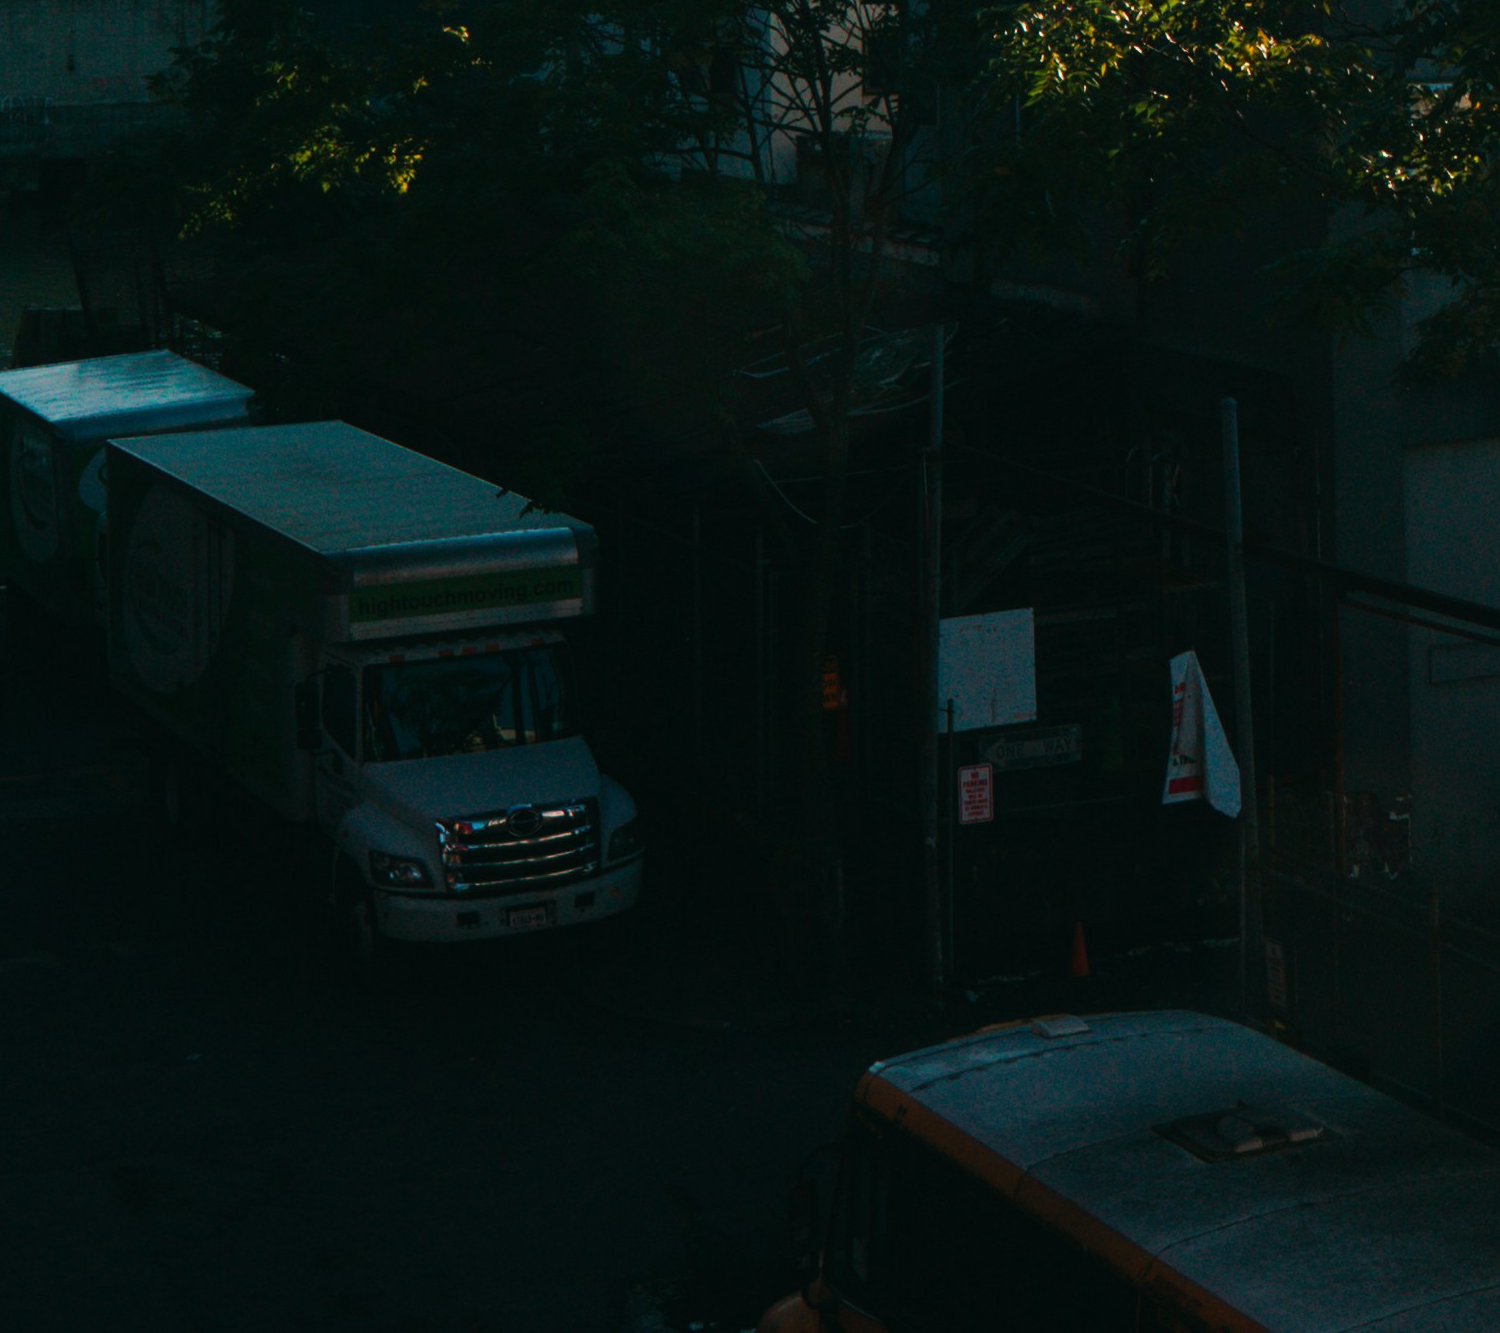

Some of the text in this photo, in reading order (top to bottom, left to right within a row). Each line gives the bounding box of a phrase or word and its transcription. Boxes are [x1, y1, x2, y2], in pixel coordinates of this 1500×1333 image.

[358, 580, 573, 616] hightouchmoving.com
[996, 738, 1075, 760] ONE WAY
